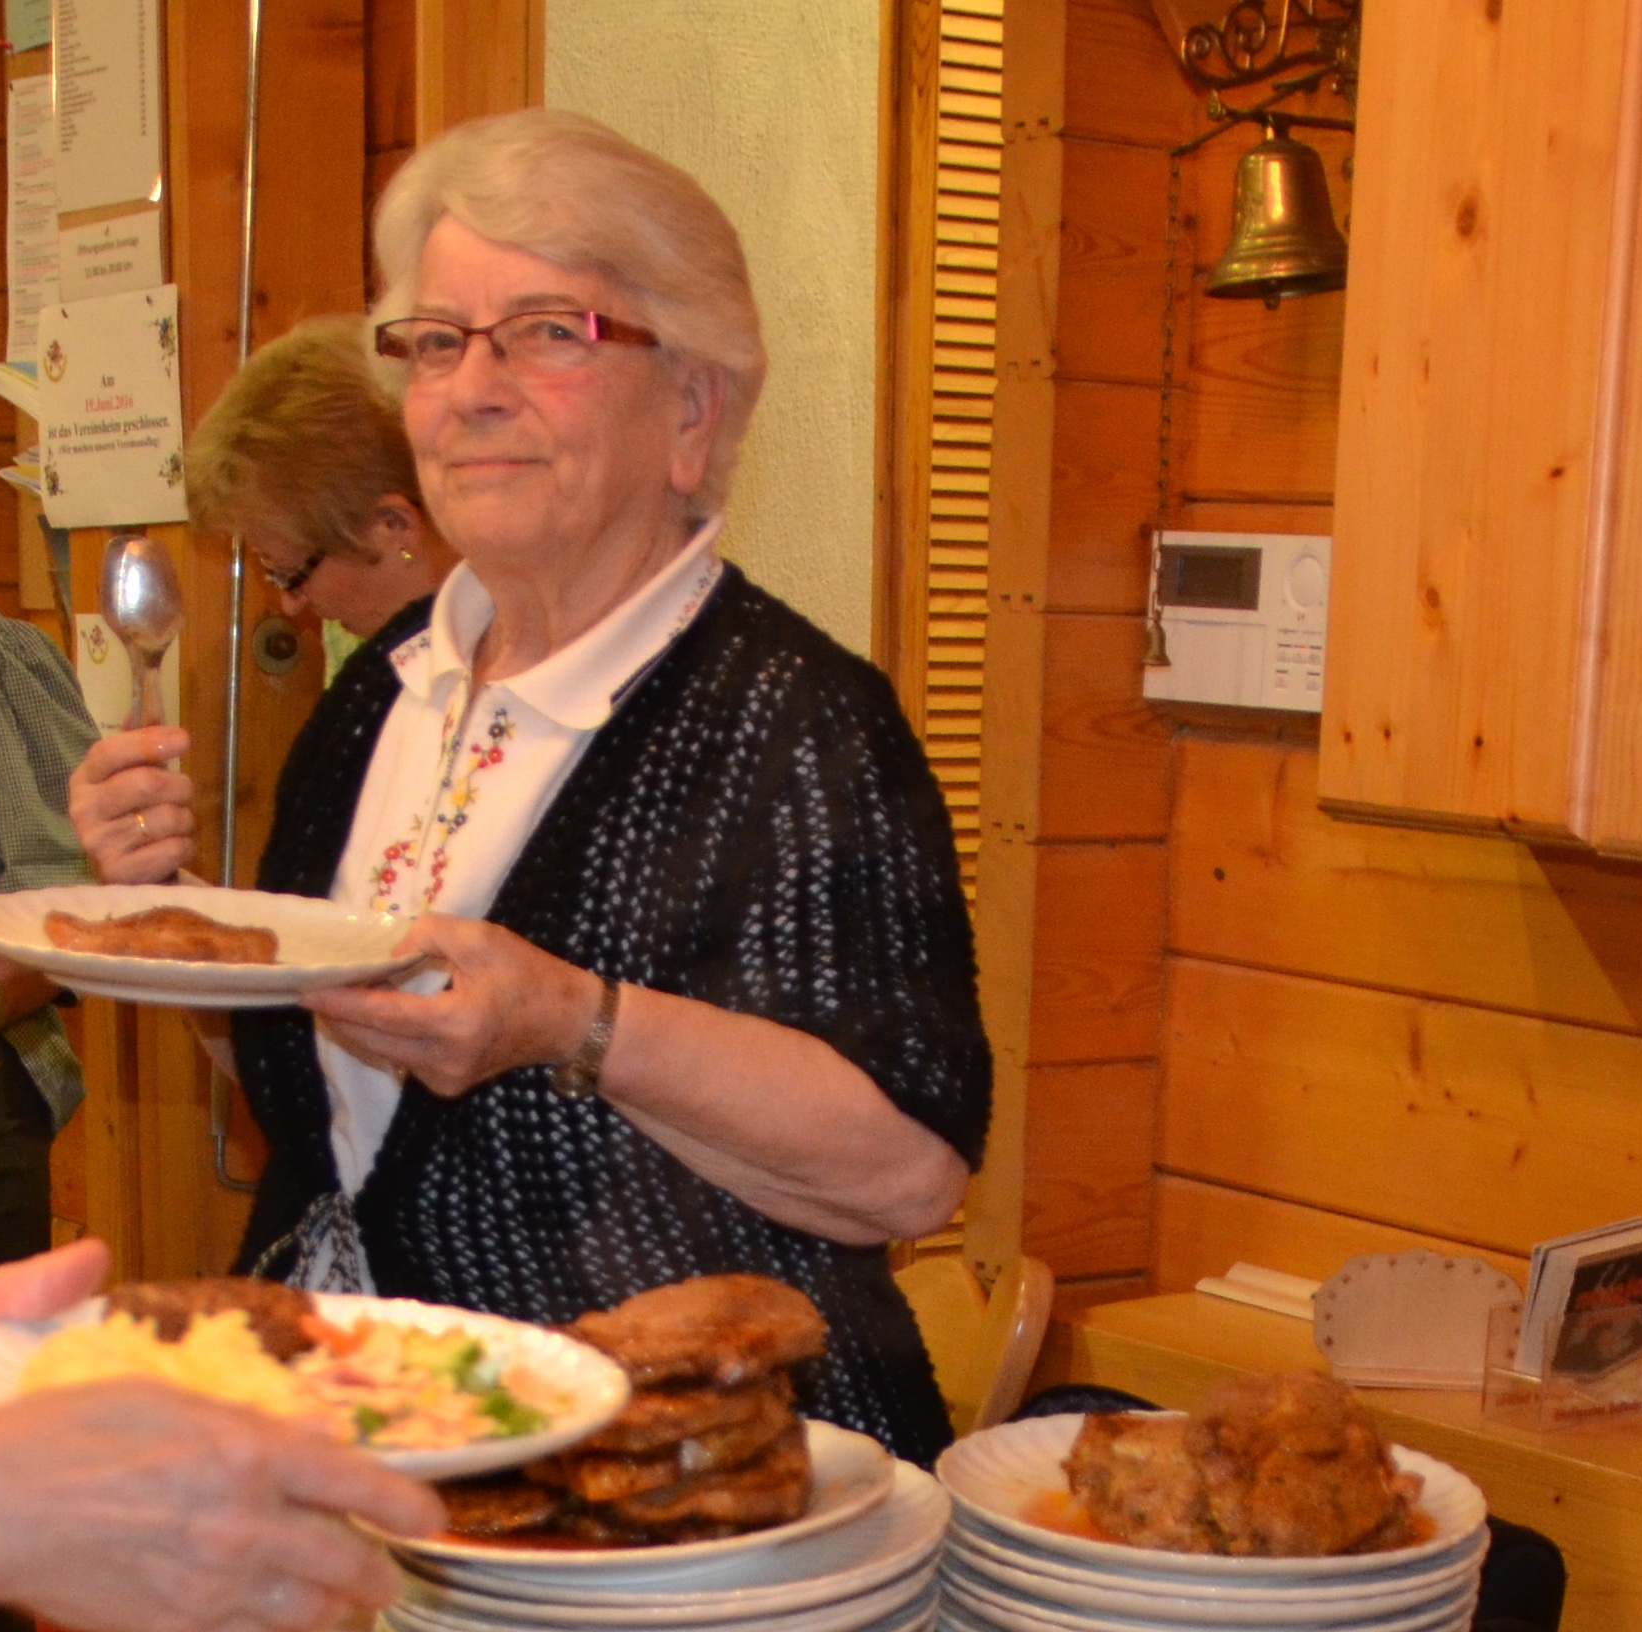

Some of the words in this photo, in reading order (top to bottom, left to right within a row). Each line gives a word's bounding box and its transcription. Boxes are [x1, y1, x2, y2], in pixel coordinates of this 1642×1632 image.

[102, 375, 115, 387] Am
[59, 423, 72, 438] das
[74, 420, 121, 436] Vereinsheim
